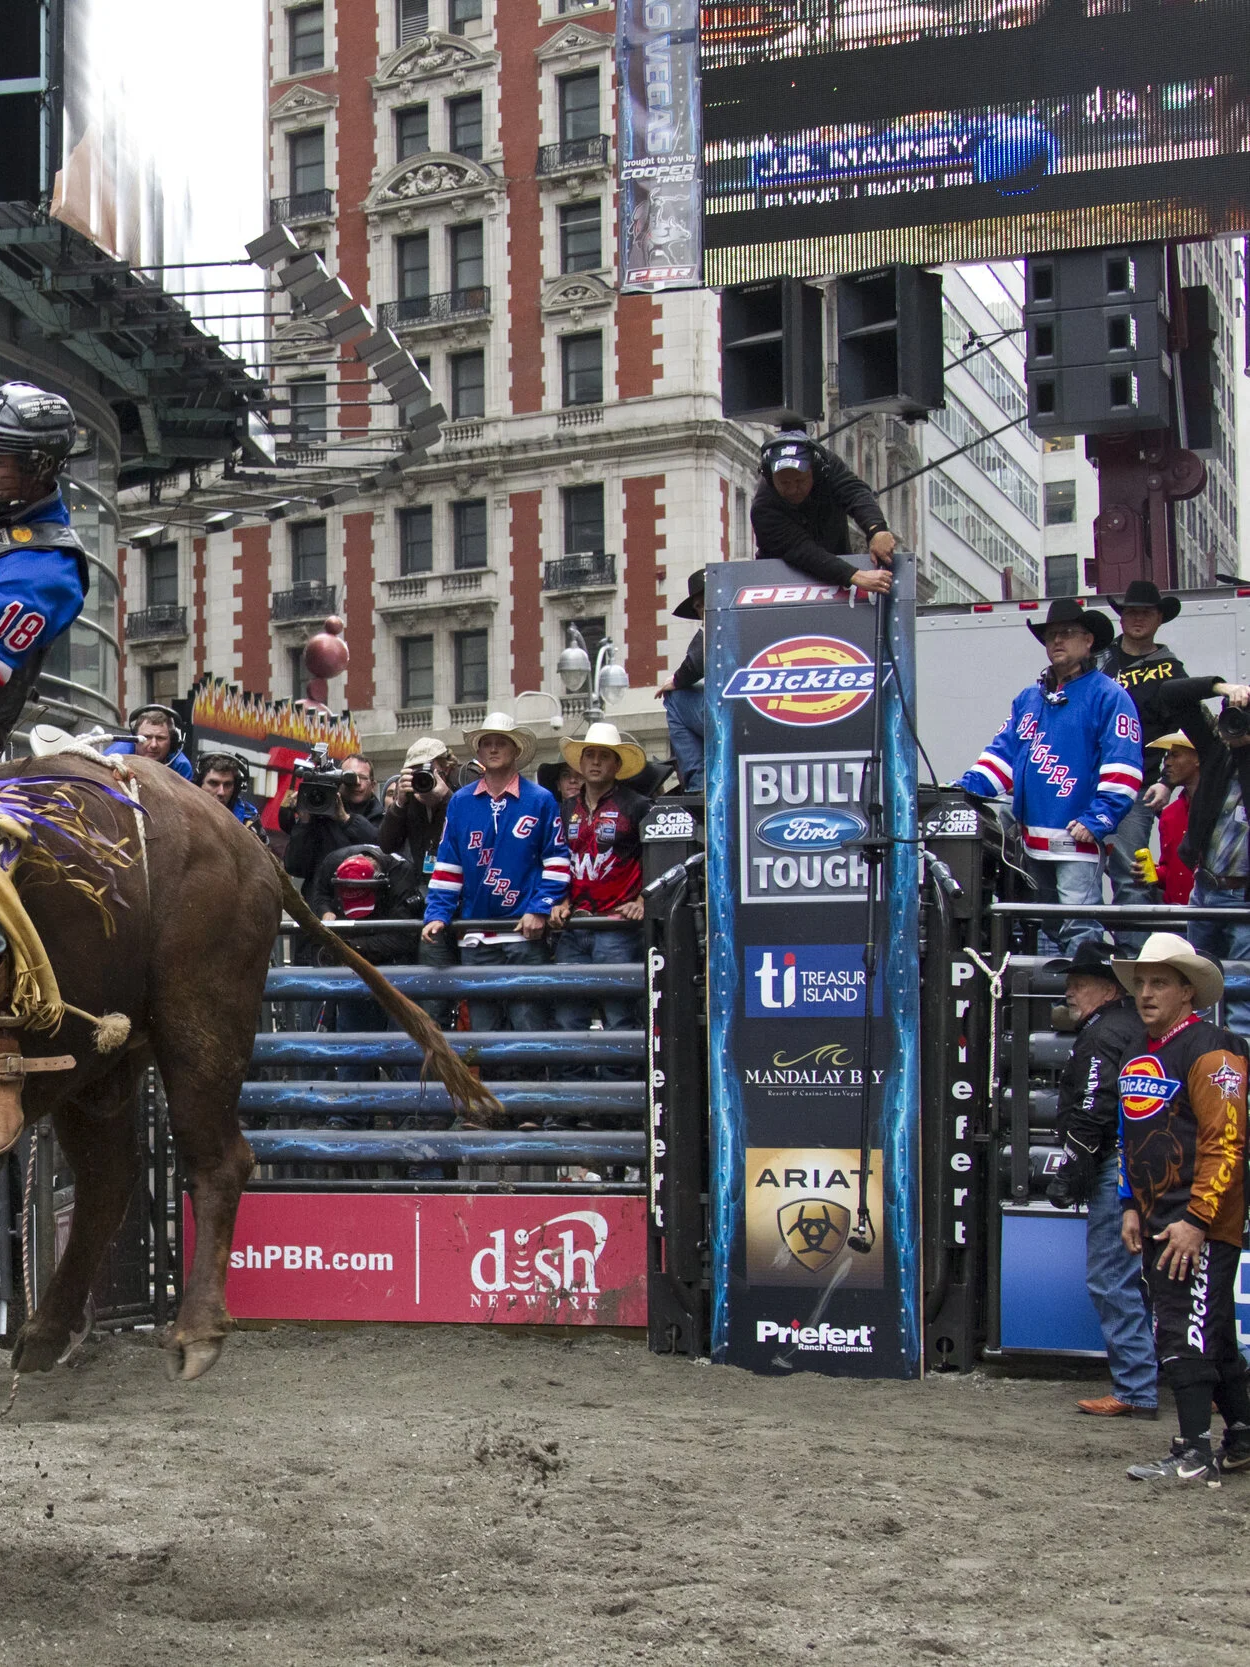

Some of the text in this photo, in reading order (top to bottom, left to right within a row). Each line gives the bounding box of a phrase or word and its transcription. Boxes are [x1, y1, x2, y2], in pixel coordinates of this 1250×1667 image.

[645, 34, 672, 154] VEGAS
[621, 165, 695, 181] COOPER
[623, 154, 697, 169] brought to you by
[656, 173, 694, 184] TIRES
[629, 267, 692, 284] PBR
[741, 586, 840, 604] PBR
[739, 669, 875, 692] Dickies
[1115, 713, 1141, 744] 85
[752, 763, 871, 805] BUILT
[512, 815, 539, 839] C
[667, 812, 693, 824] CBS
[950, 810, 977, 821] CBS
[645, 823, 693, 838] SPORTS
[783, 817, 840, 841] Ford
[468, 830, 520, 907] RNERS
[752, 855, 870, 889] TOUGH
[754, 951, 796, 1009] ti
[800, 971, 866, 986] TREASUR
[803, 987, 858, 1002] ISLAND
[1161, 1020, 1190, 1044] Dickies
[744, 1069, 885, 1085] MANDALAY BY
[1120, 1077, 1169, 1096] Dickies
[651, 954, 667, 1227] Priefert
[768, 1089, 789, 1097] Resort
[792, 1089, 797, 1097] &
[842, 1089, 862, 1098] Vegas
[950, 962, 975, 1244] Priefert
[1202, 1101, 1238, 1219] Dickies
[471, 1214, 607, 1293] dish
[470, 1293, 602, 1310] NETWORK
[1187, 1240, 1211, 1354] Dickies
[756, 1319, 872, 1346] Priefert
[798, 1343, 873, 1354] Ranch Equipment
